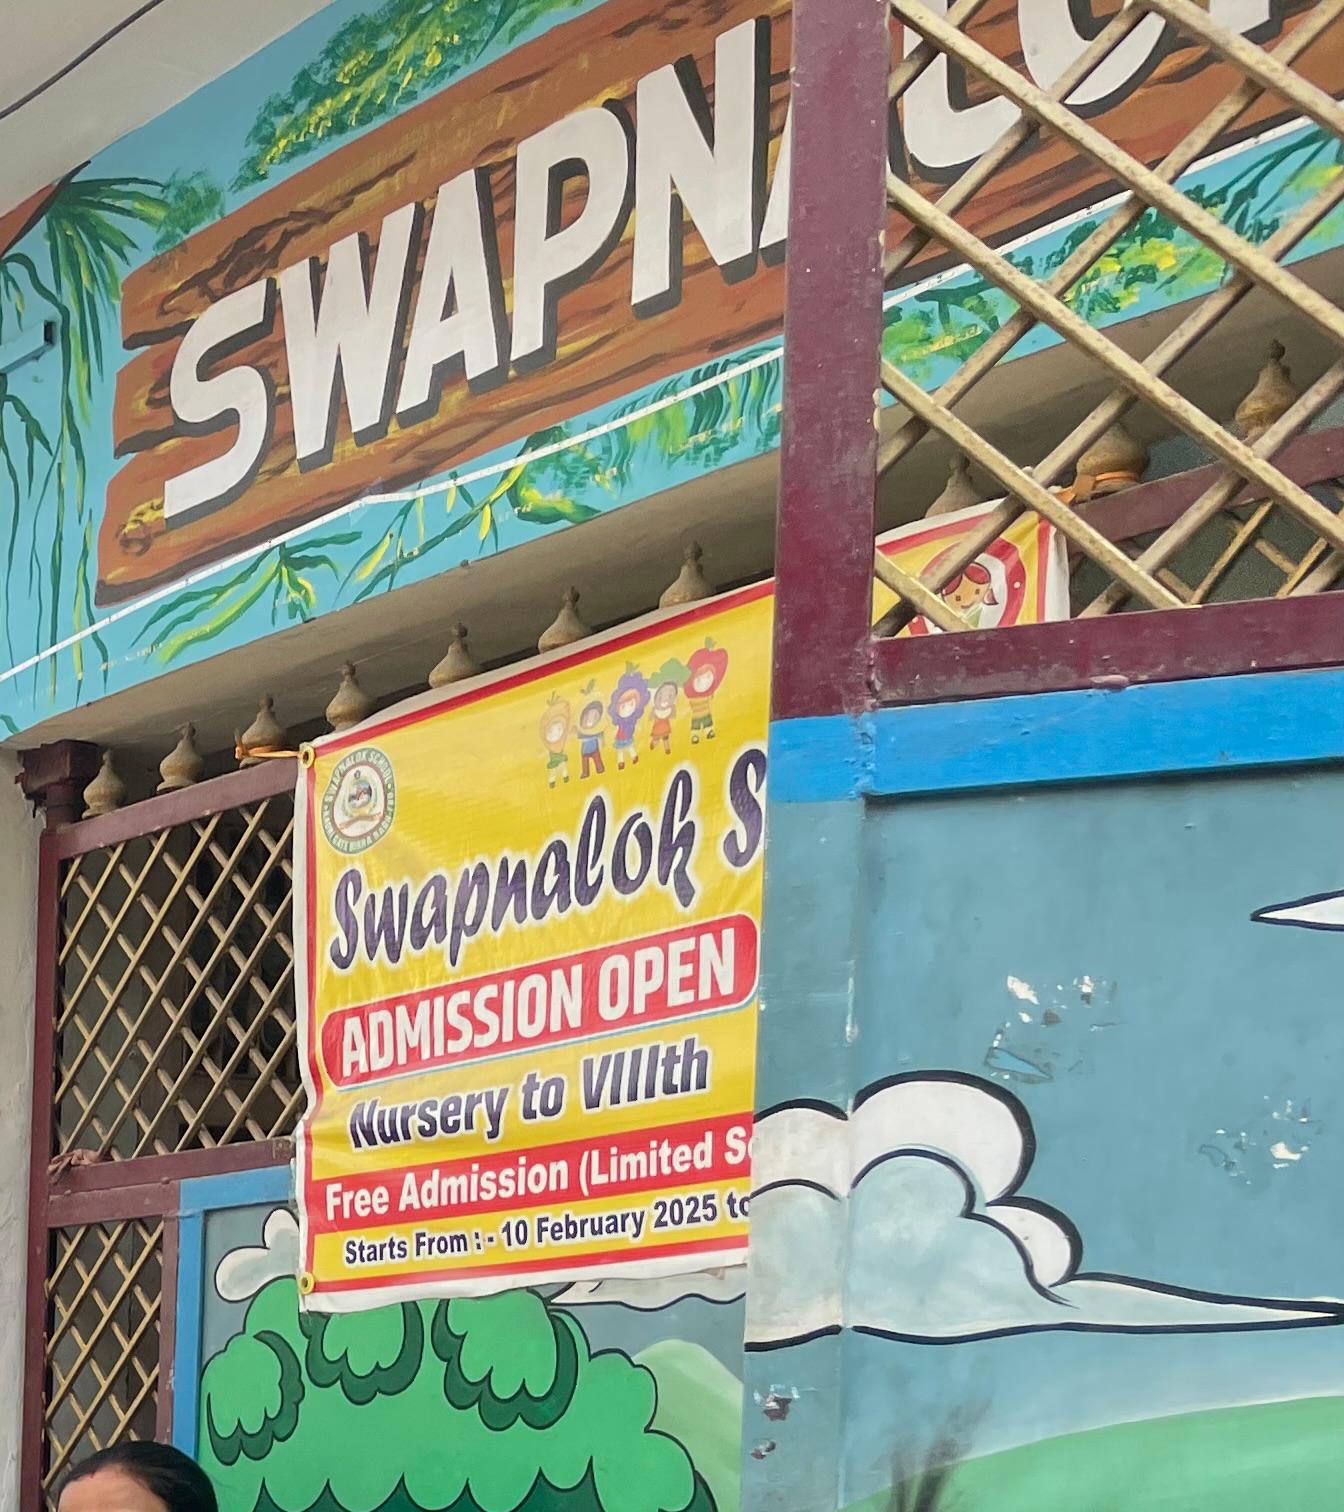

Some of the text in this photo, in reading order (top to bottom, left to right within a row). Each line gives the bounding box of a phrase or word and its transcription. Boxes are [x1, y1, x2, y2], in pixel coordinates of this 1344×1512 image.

[330, 769, 696, 970] Swapnalok
[341, 928, 735, 1078] ADMISSION OPEN
[349, 1037, 709, 1149] Nursery to VIIIth
[325, 1182, 389, 1221] Free
[398, 1156, 569, 1211] Admission
[580, 1131, 712, 1196] (Limited
[345, 1238, 407, 1264] Starts
[415, 1230, 468, 1258] From
[501, 1220, 528, 1248] 10
[536, 1208, 645, 1243] February
[653, 1194, 717, 1229] 2025
